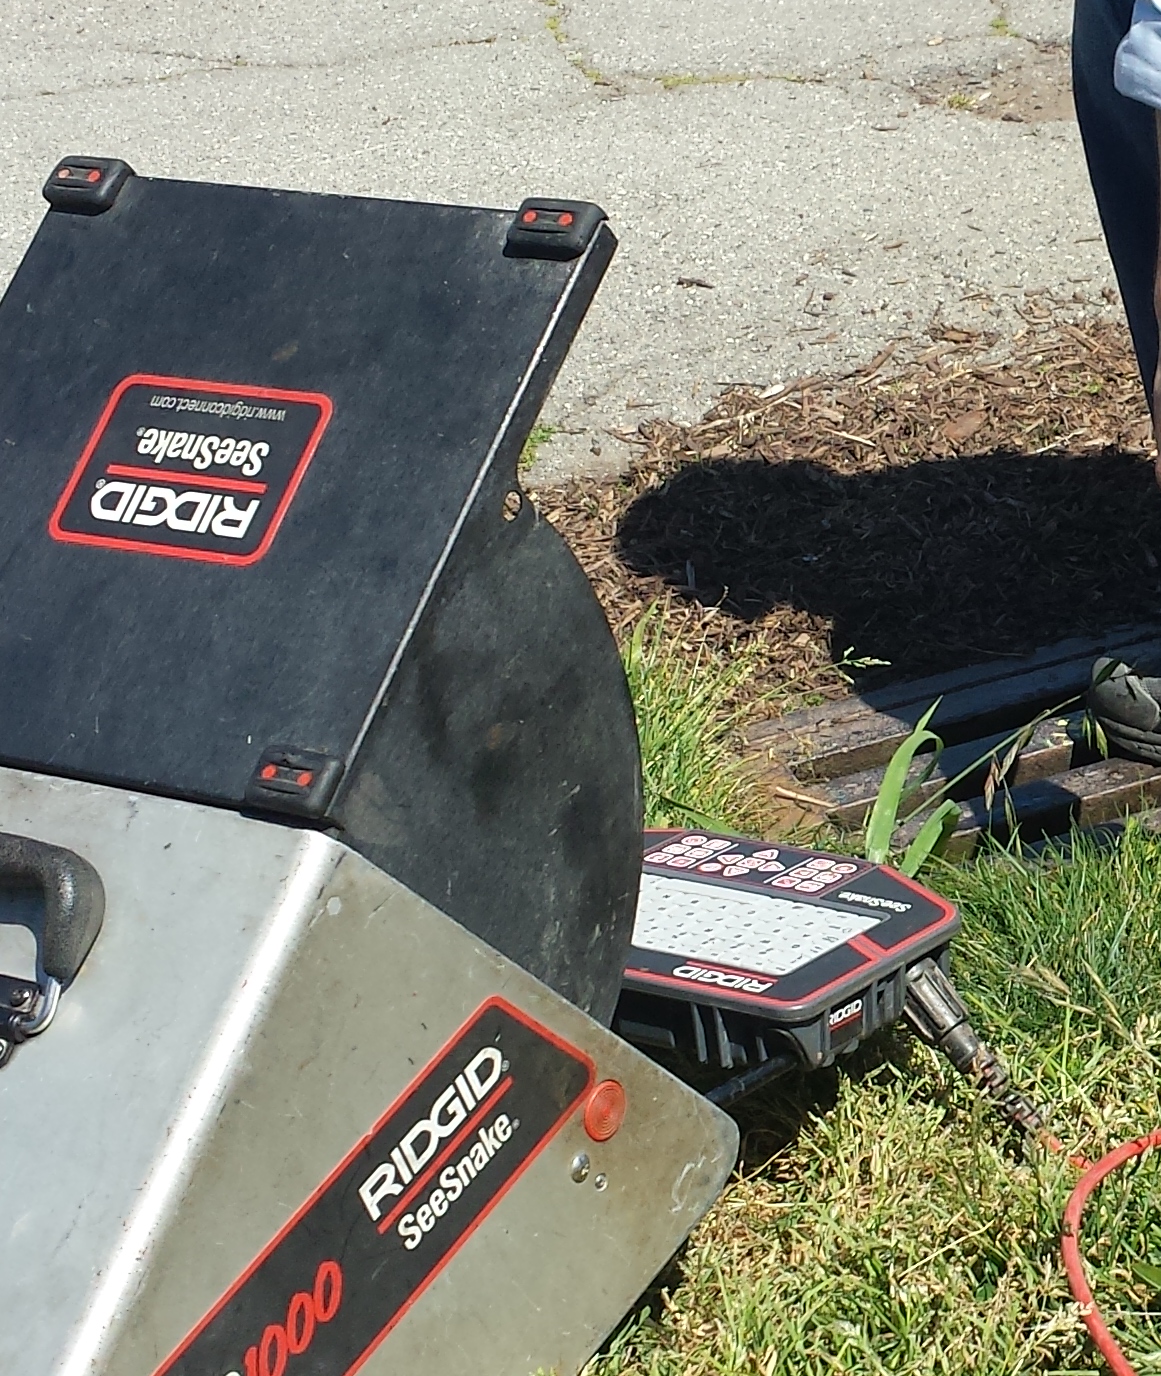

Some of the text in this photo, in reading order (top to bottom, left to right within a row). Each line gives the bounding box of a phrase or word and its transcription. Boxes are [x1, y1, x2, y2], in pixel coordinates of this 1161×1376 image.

[150, 394, 286, 422] www.ridgidconnect.com
[137, 427, 270, 477] SeeSnake
[90, 479, 261, 539] RIDGID
[672, 965, 774, 994] RIDGID
[358, 1045, 504, 1222] RIDGID
[397, 1113, 513, 1252] SeeSnake
